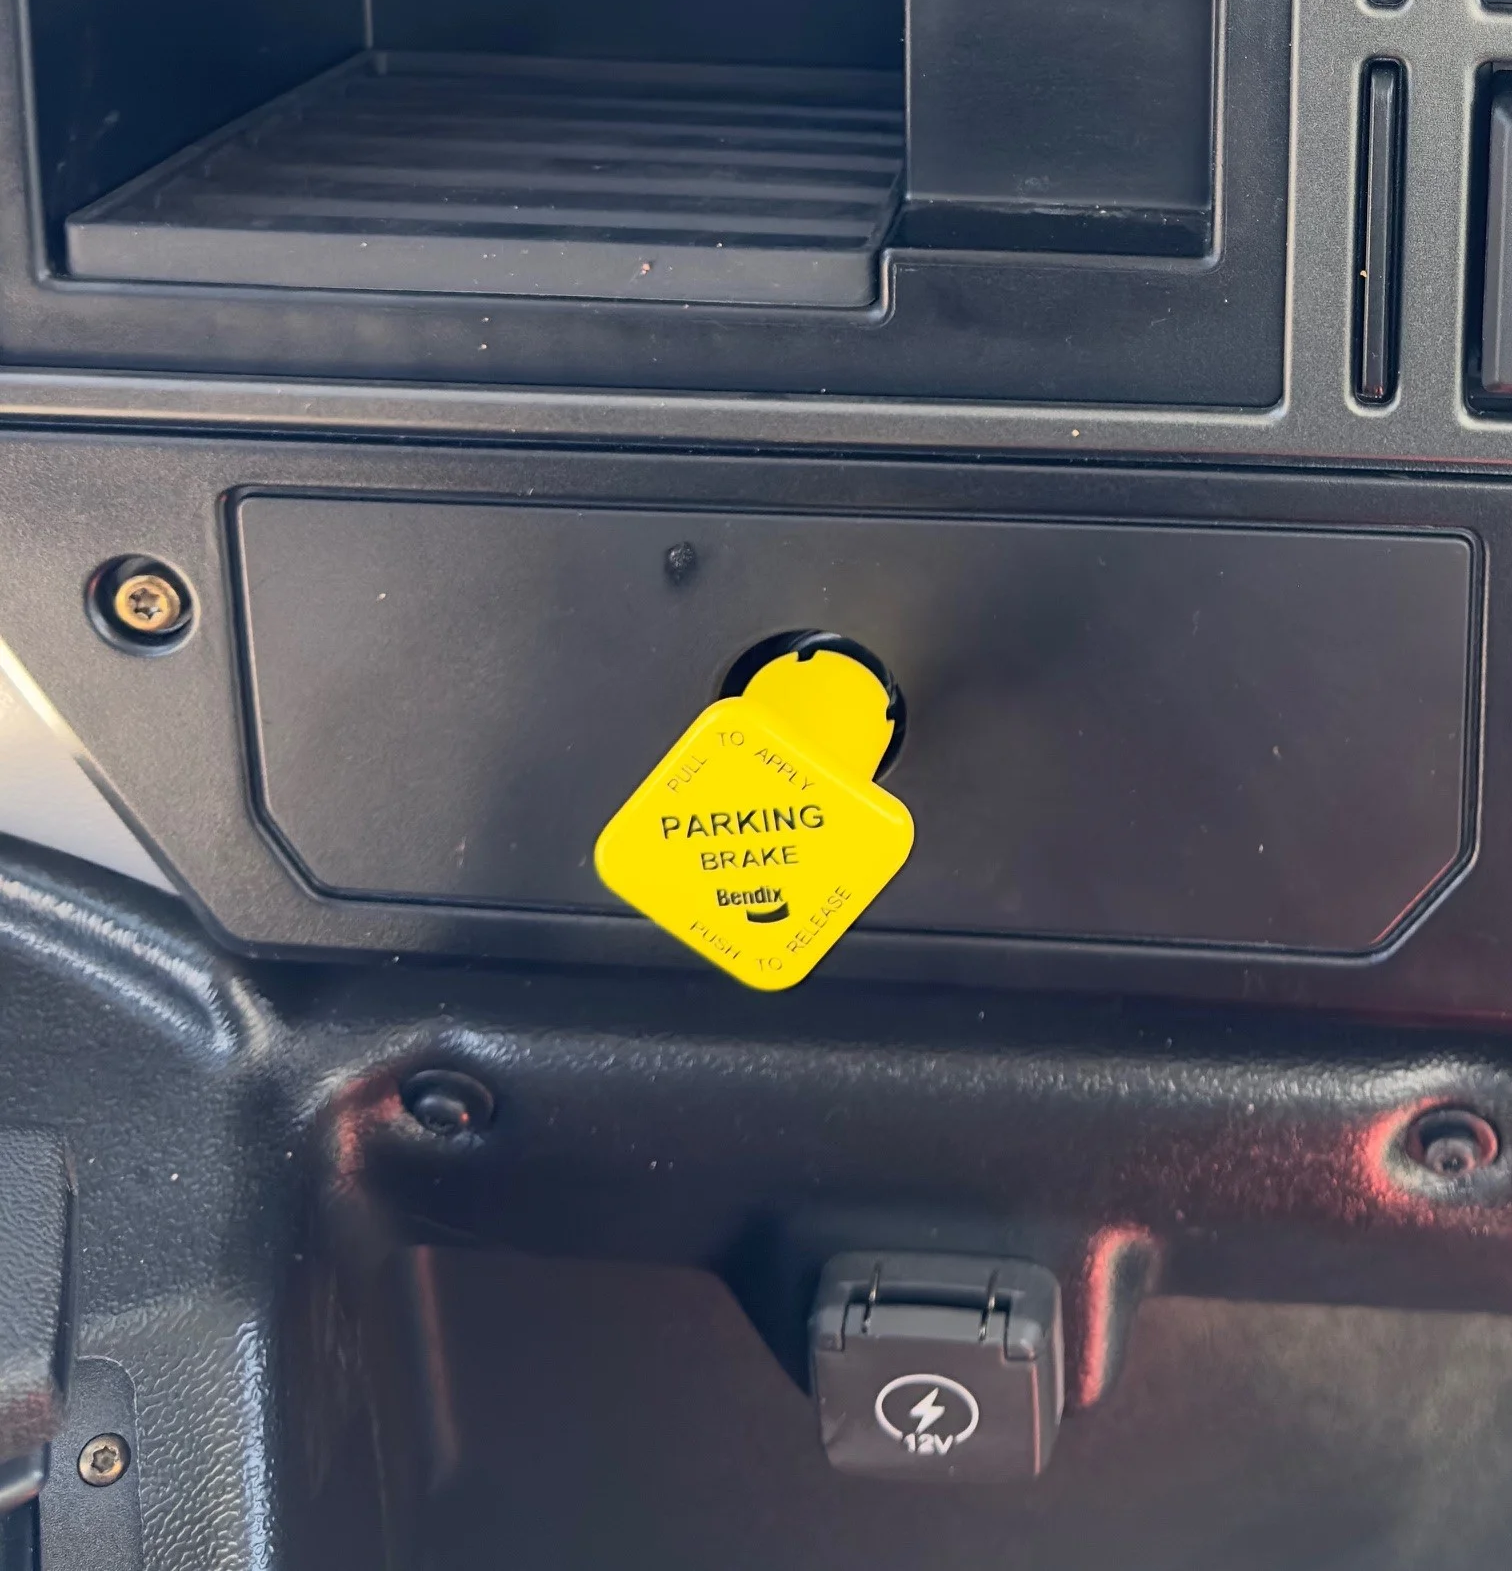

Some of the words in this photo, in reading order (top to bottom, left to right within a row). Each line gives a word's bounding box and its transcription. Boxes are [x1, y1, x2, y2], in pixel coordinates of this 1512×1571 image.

[667, 755, 707, 792] PULL
[717, 731, 744, 747] TO
[754, 747, 815, 791] APPLY
[661, 804, 825, 839] PARKING
[700, 845, 799, 870] BRAKE
[717, 886, 783, 906] Bendix
[689, 920, 741, 959] PUSH
[755, 958, 783, 972] TO
[786, 885, 852, 955] RELEASE
[903, 1433, 954, 1455] 12V
